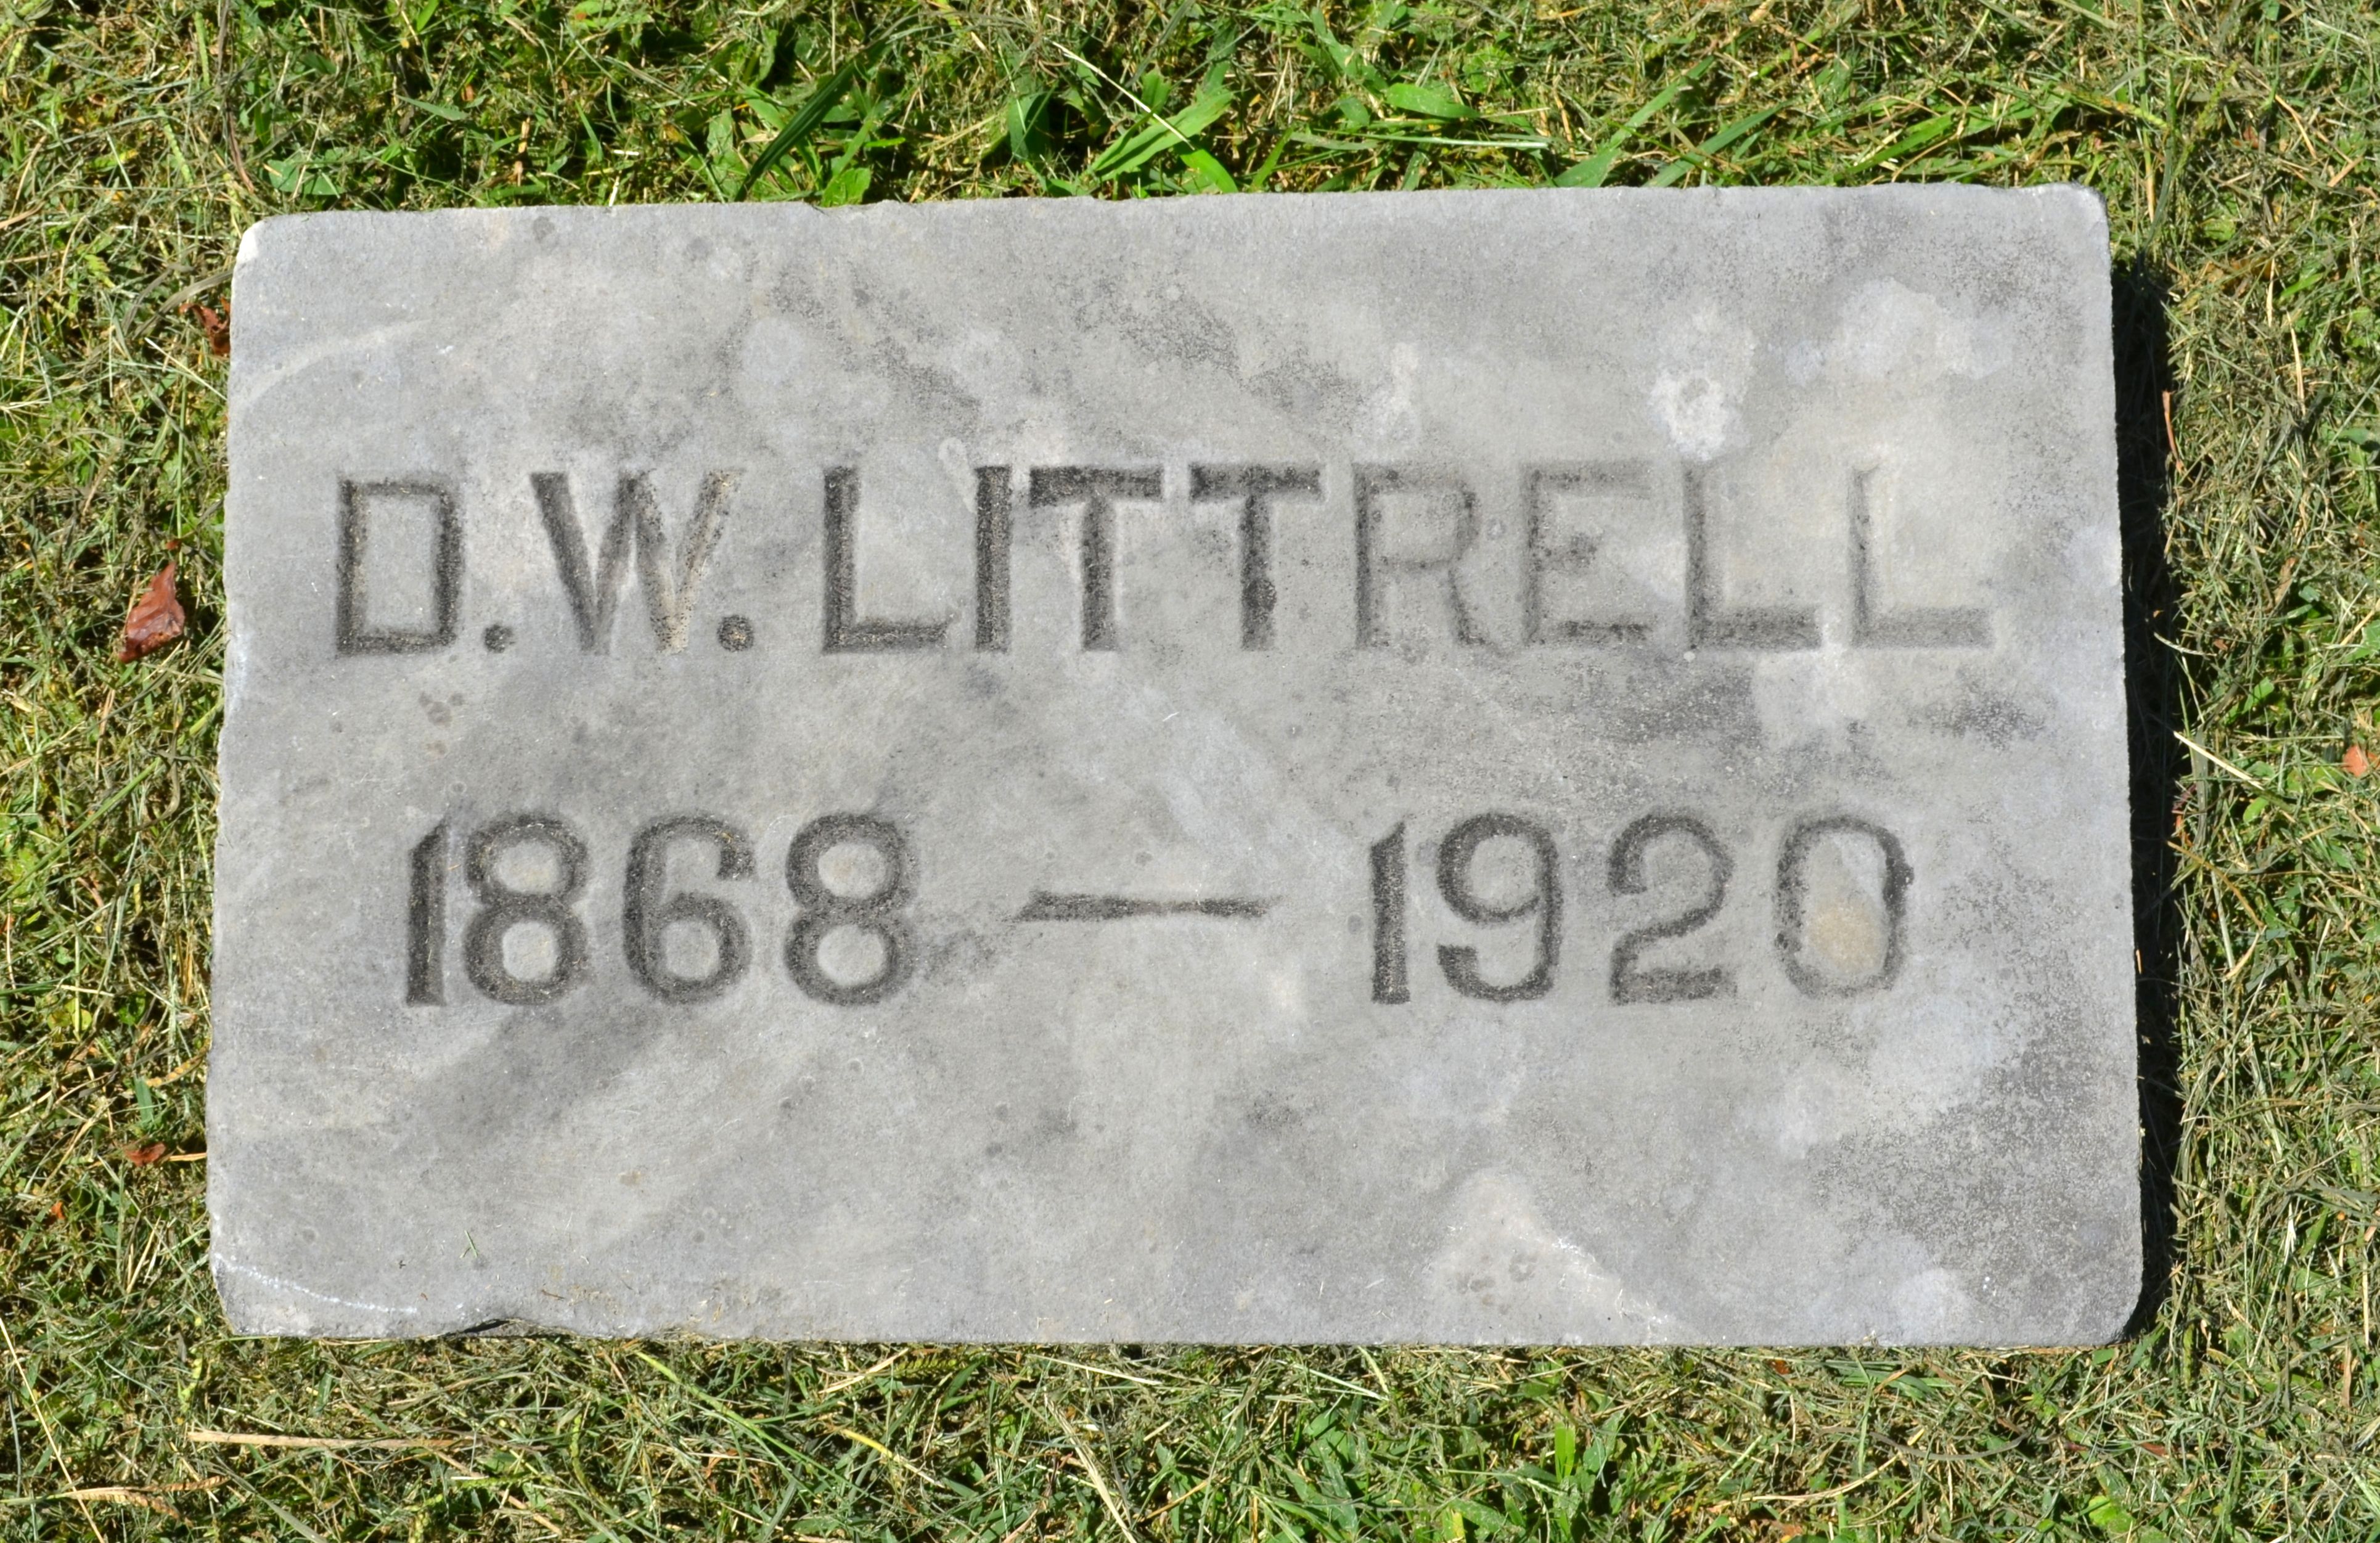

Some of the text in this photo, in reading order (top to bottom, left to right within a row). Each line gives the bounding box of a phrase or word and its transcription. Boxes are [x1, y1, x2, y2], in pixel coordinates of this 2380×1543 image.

[822, 461, 1994, 653] LITTRELL
[406, 811, 917, 1005] 1868
[1370, 811, 1912, 1005] 1920
